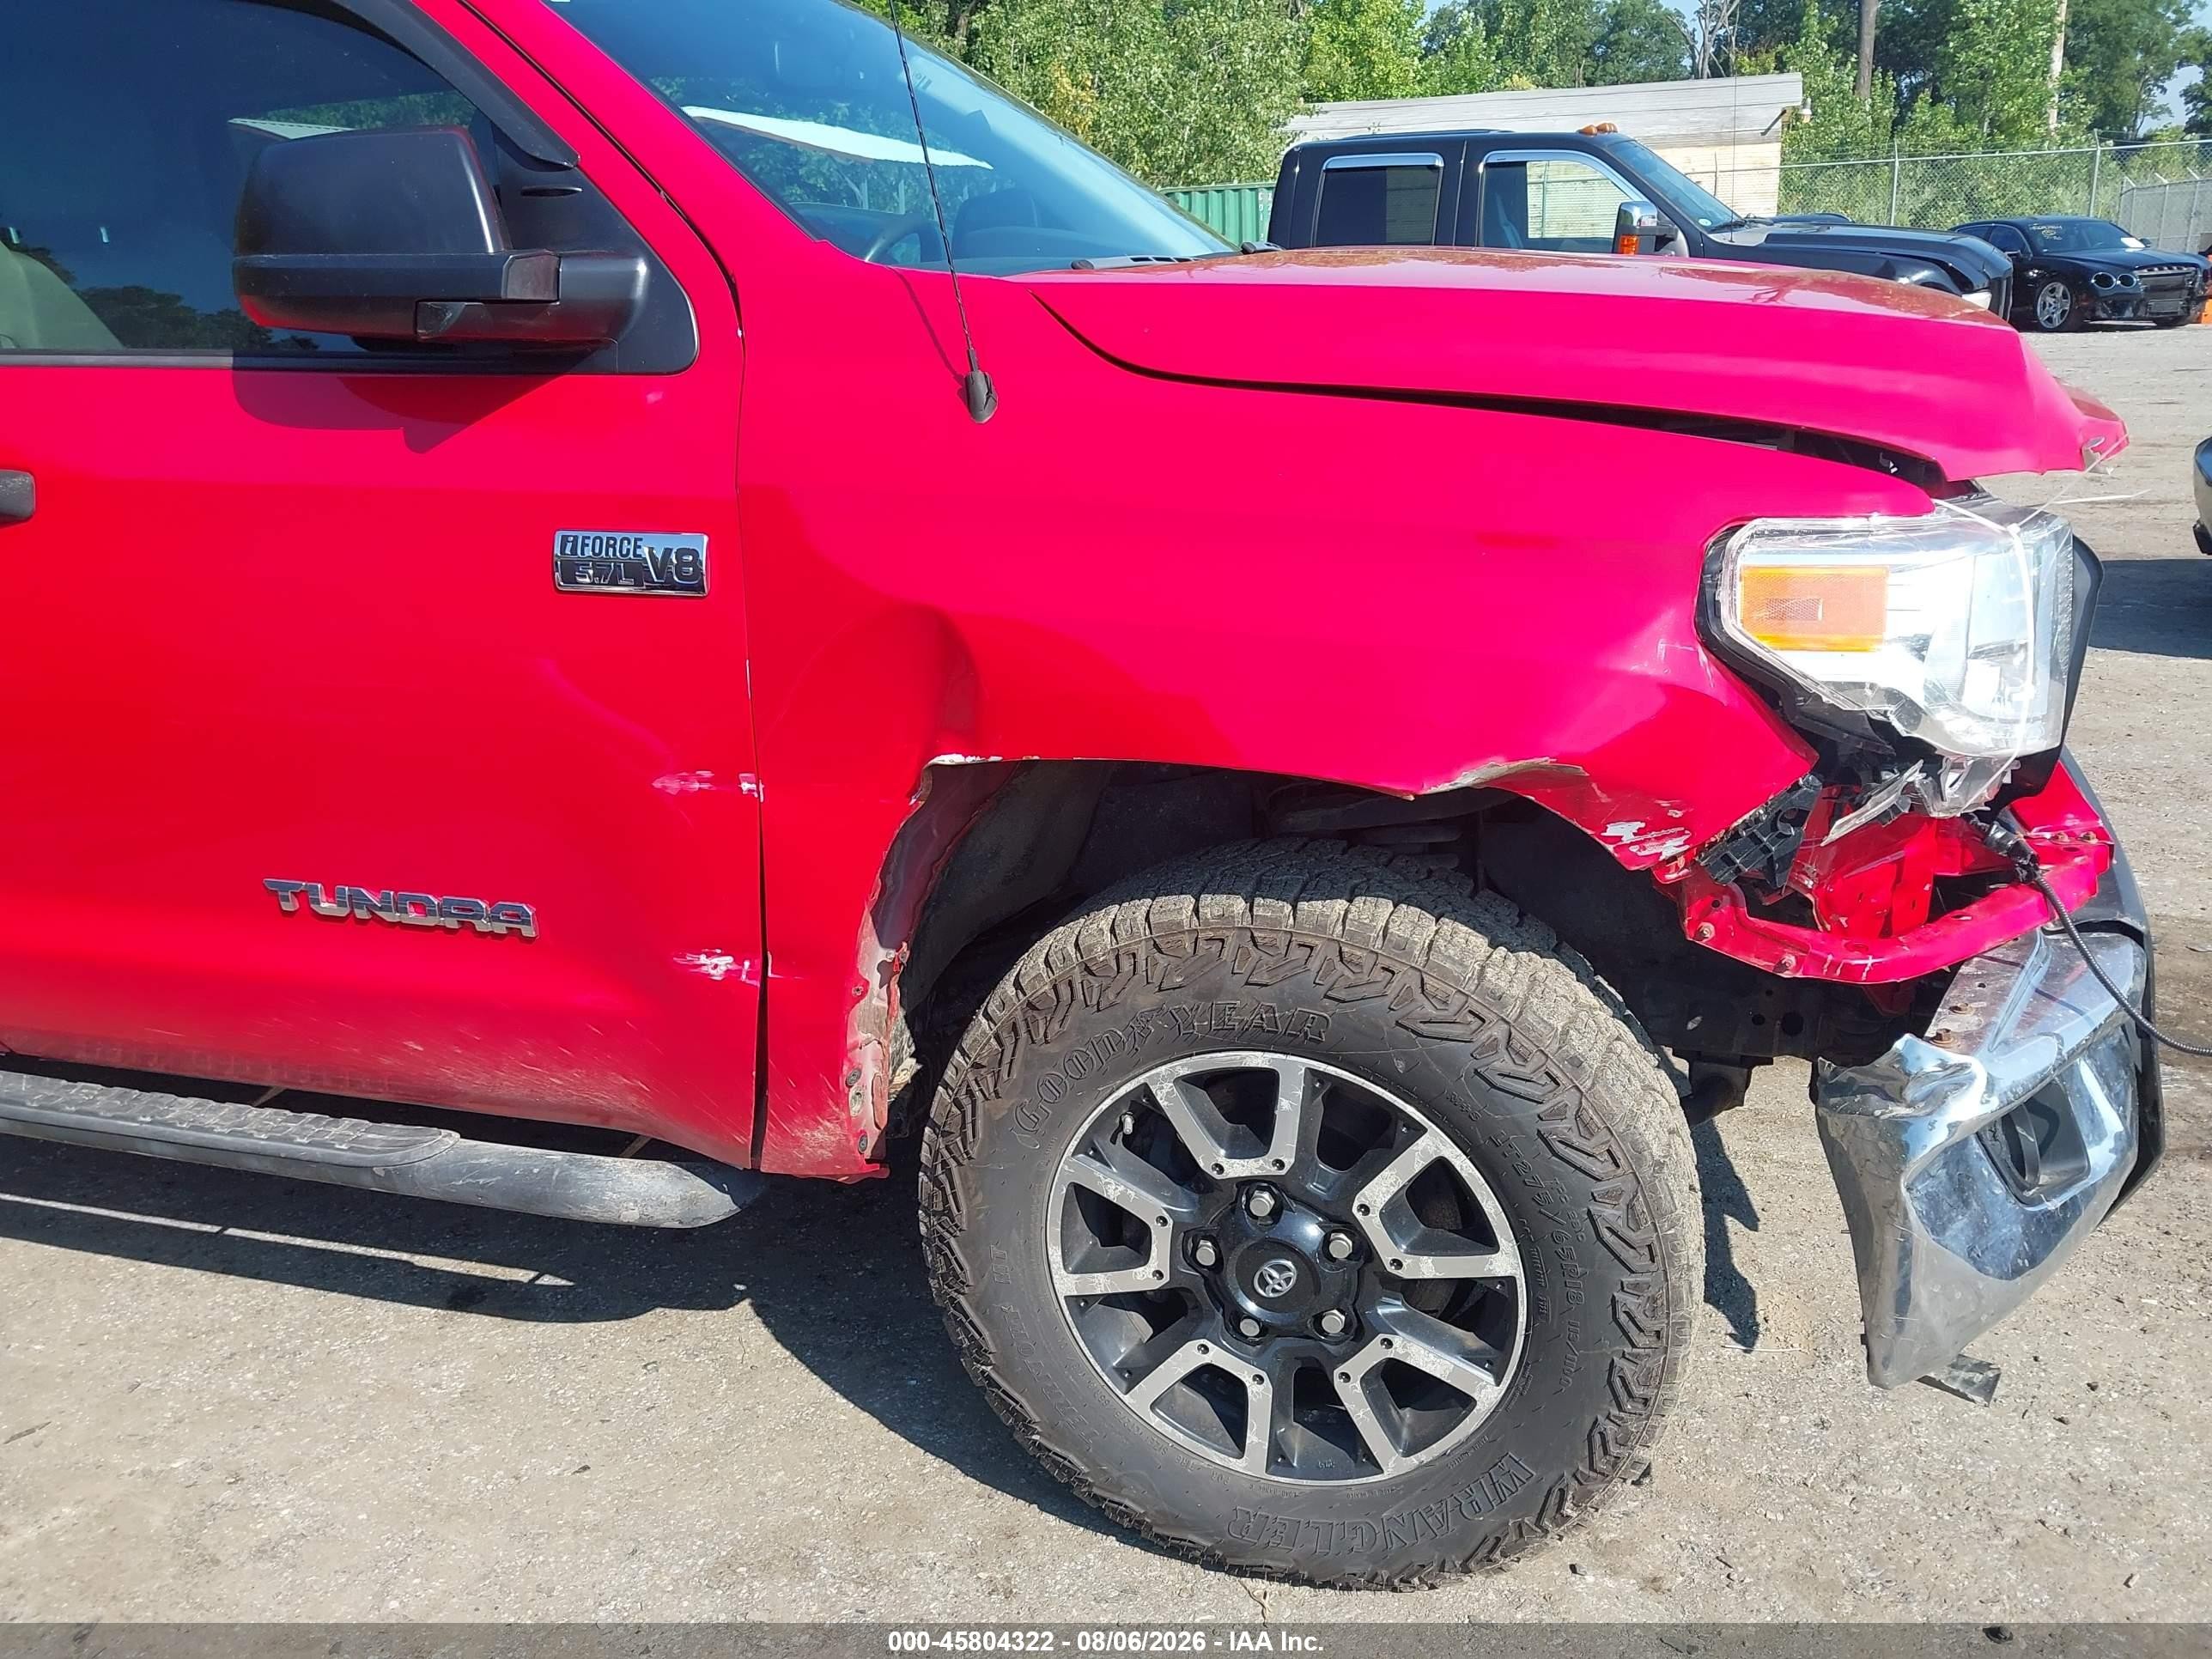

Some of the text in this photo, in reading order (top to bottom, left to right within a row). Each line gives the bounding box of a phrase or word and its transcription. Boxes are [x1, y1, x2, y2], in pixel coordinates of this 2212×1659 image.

[574, 561, 635, 585] 5.7L
[646, 547, 702, 584] V8
[263, 878, 538, 938] TUNDRA
